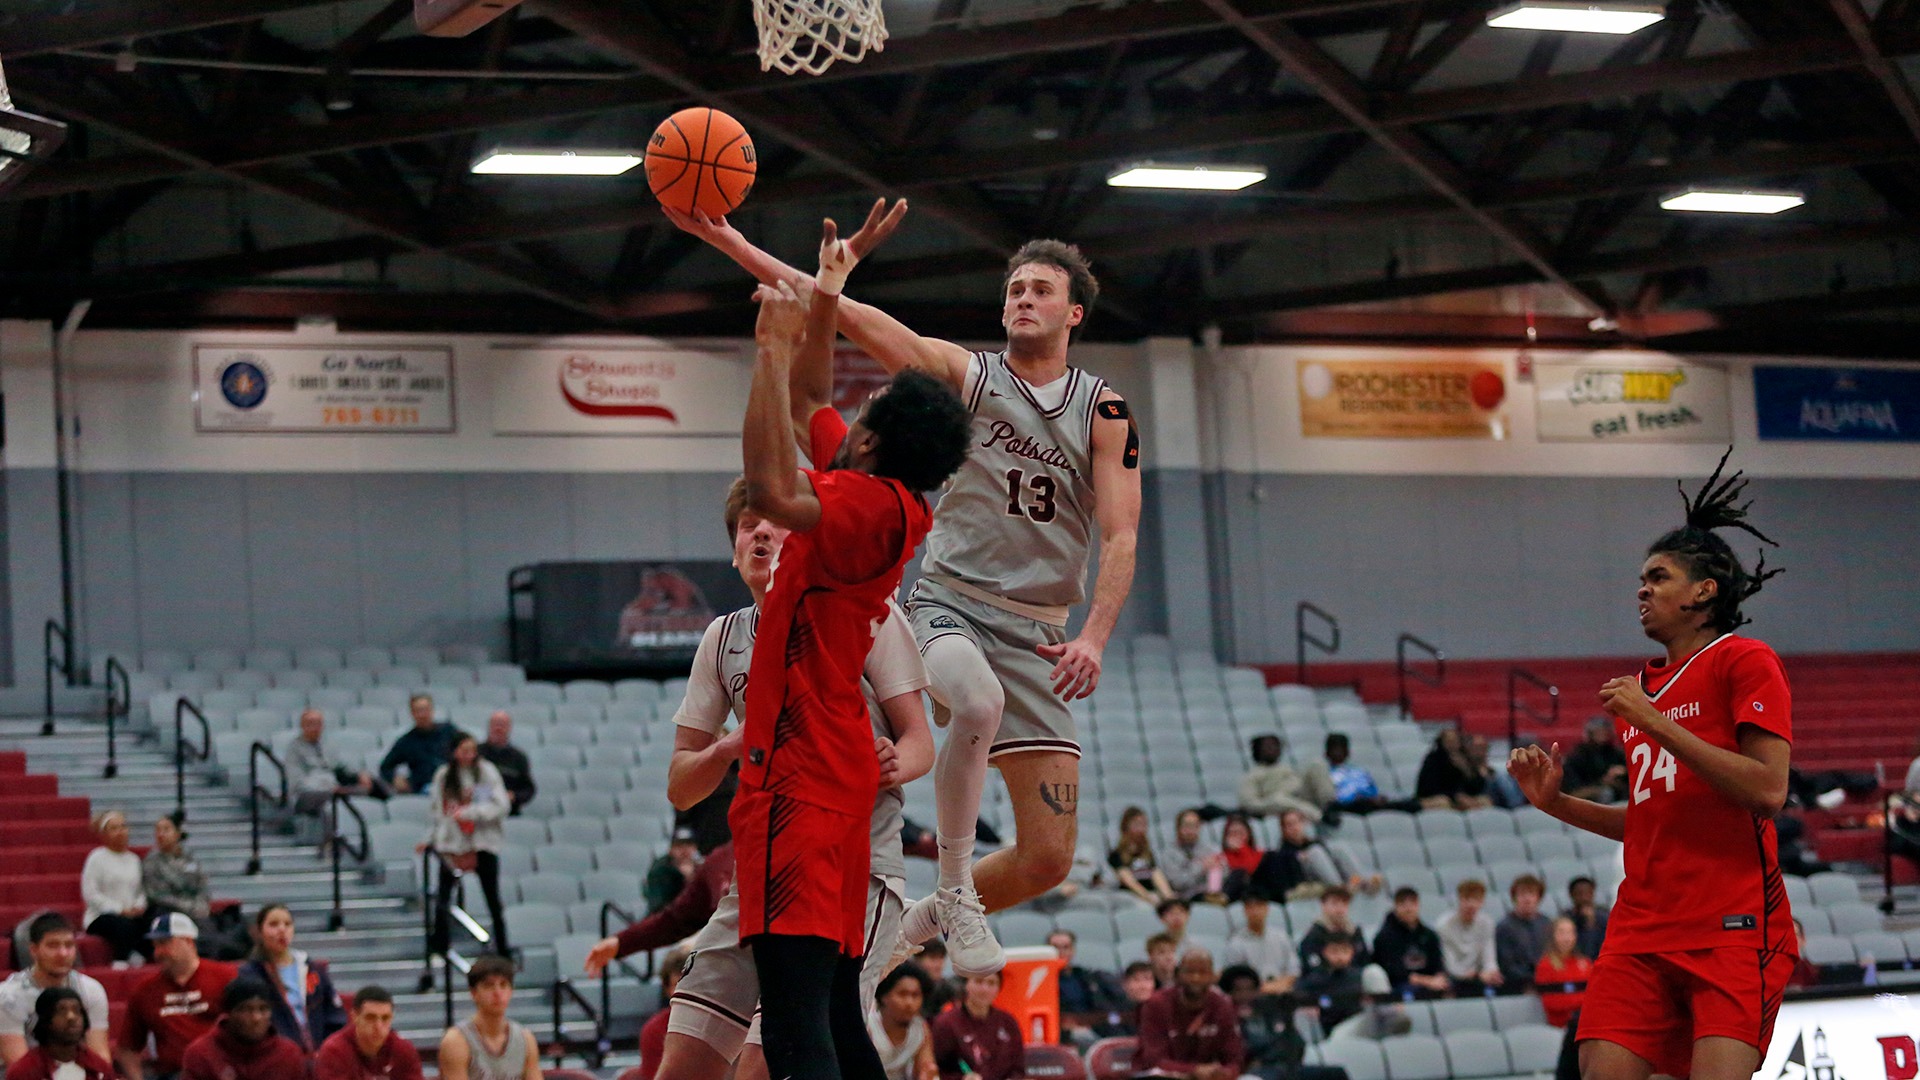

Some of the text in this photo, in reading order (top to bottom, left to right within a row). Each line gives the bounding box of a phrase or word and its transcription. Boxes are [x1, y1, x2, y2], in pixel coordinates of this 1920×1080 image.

[1335, 372, 1470, 397] ROCHESTER
[1569, 367, 1686, 404] SUBWAY
[1591, 415, 1628, 438] eat
[1800, 397, 1898, 432] AQUAFINA
[1005, 466, 1058, 525] 13
[1631, 742, 1677, 806] 24
